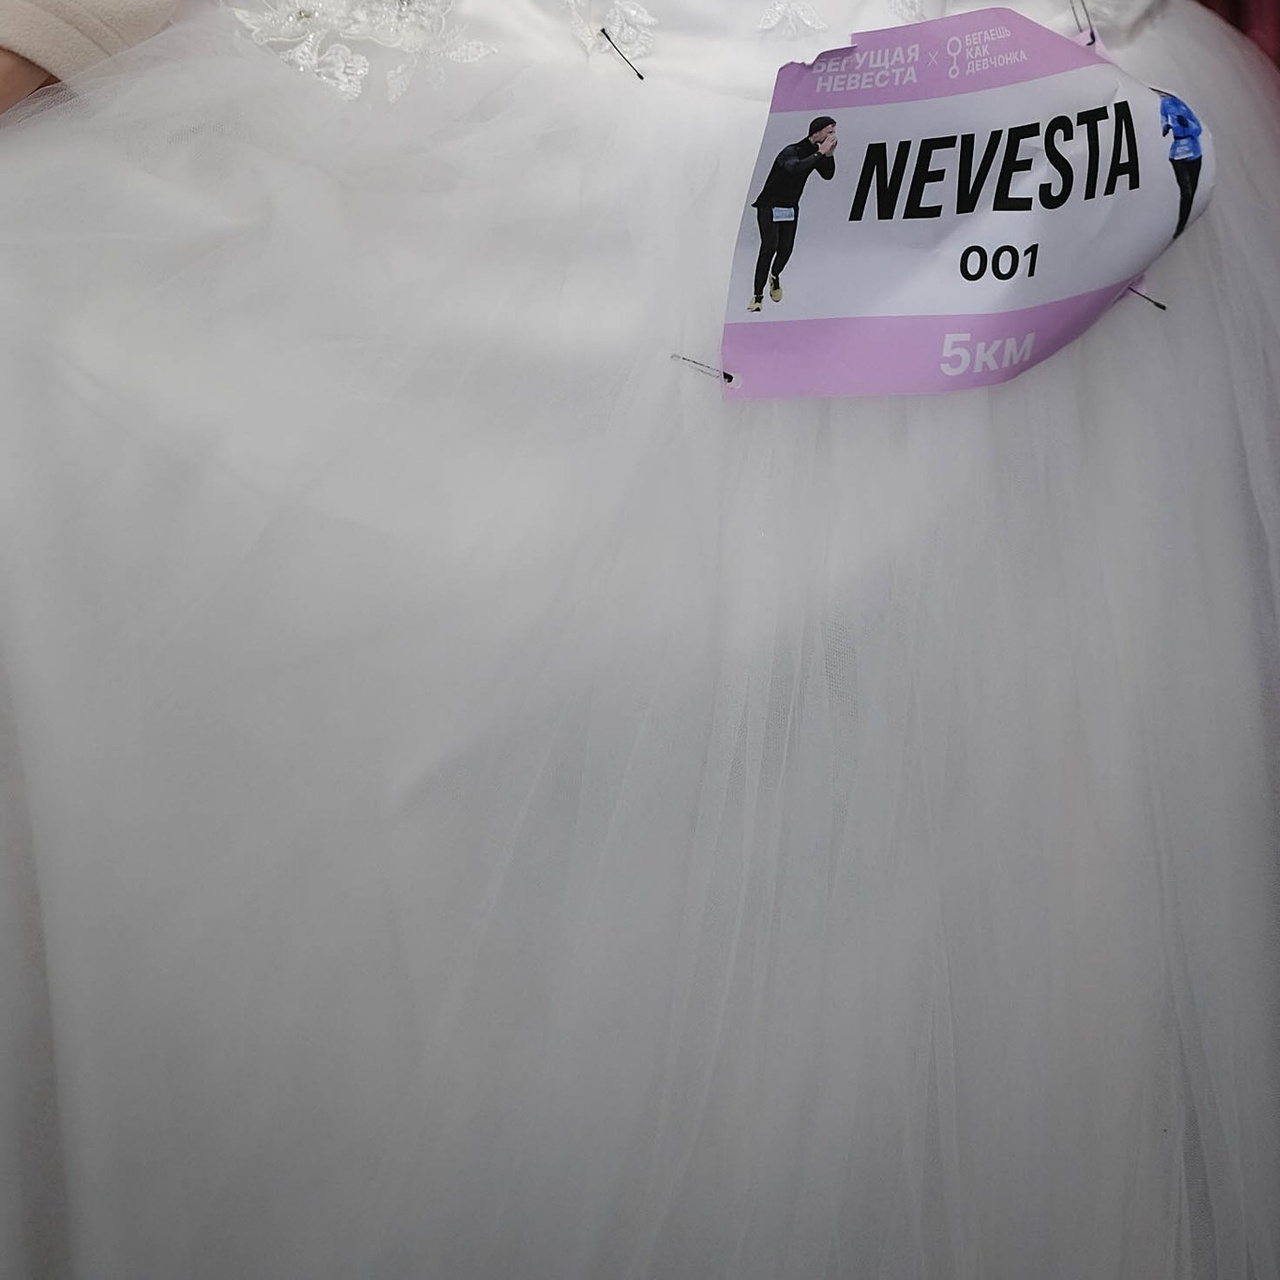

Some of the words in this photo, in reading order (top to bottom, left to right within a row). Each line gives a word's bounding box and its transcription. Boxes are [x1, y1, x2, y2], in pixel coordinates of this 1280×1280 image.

[965, 25, 1012, 47] БЕГАЕШЬ
[966, 44, 990, 58] КАК
[966, 48, 1028, 77] ДЕВЧОНКА
[815, 66, 918, 94] НЕВЕСТА
[848, 100, 1140, 223] NEVESTA
[959, 242, 1040, 282] 001
